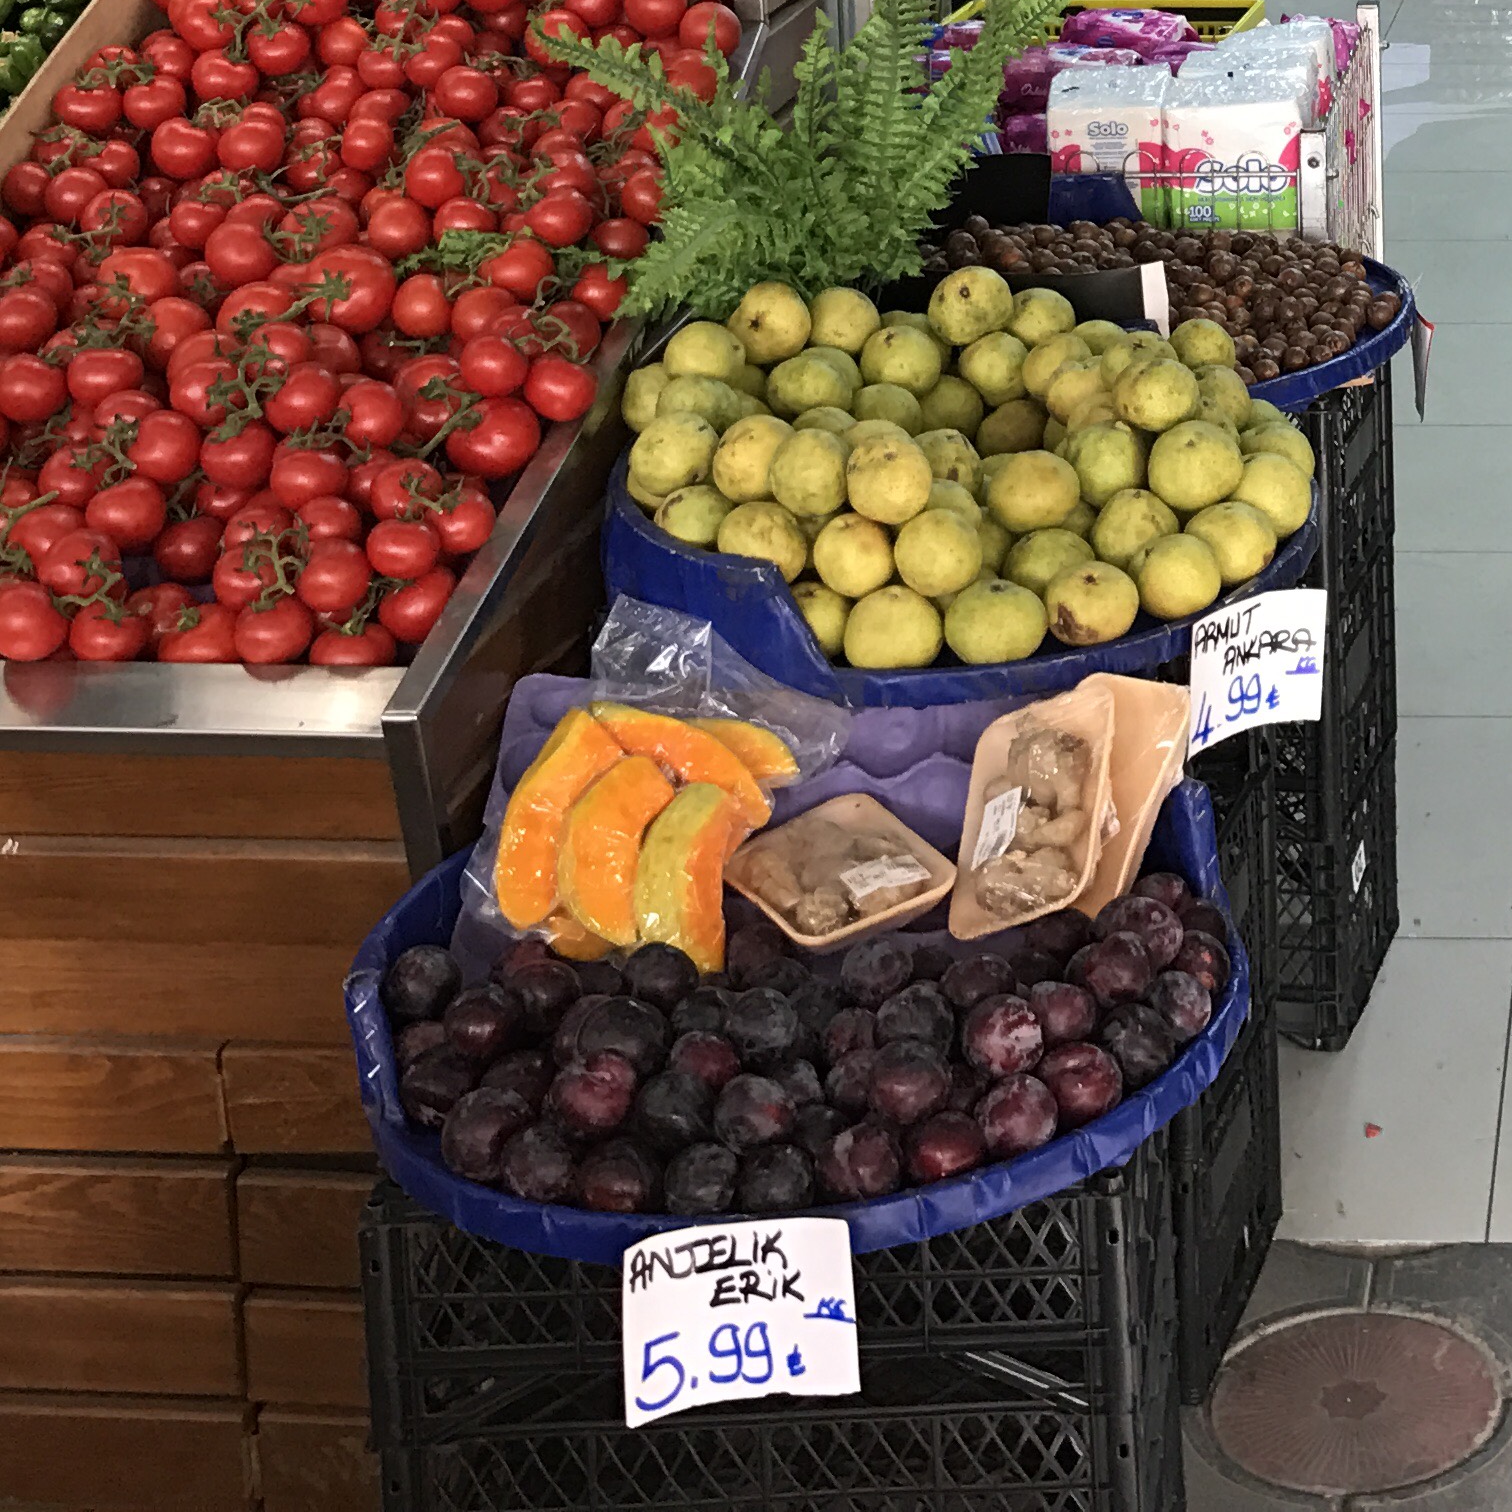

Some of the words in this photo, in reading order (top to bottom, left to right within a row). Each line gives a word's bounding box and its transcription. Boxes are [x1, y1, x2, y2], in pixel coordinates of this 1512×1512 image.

[1087, 121, 1129, 137] Solo
[1189, 205, 1212, 218] 100
[1194, 603, 1261, 659] ARMUT
[1223, 628, 1317, 675] ANKARA
